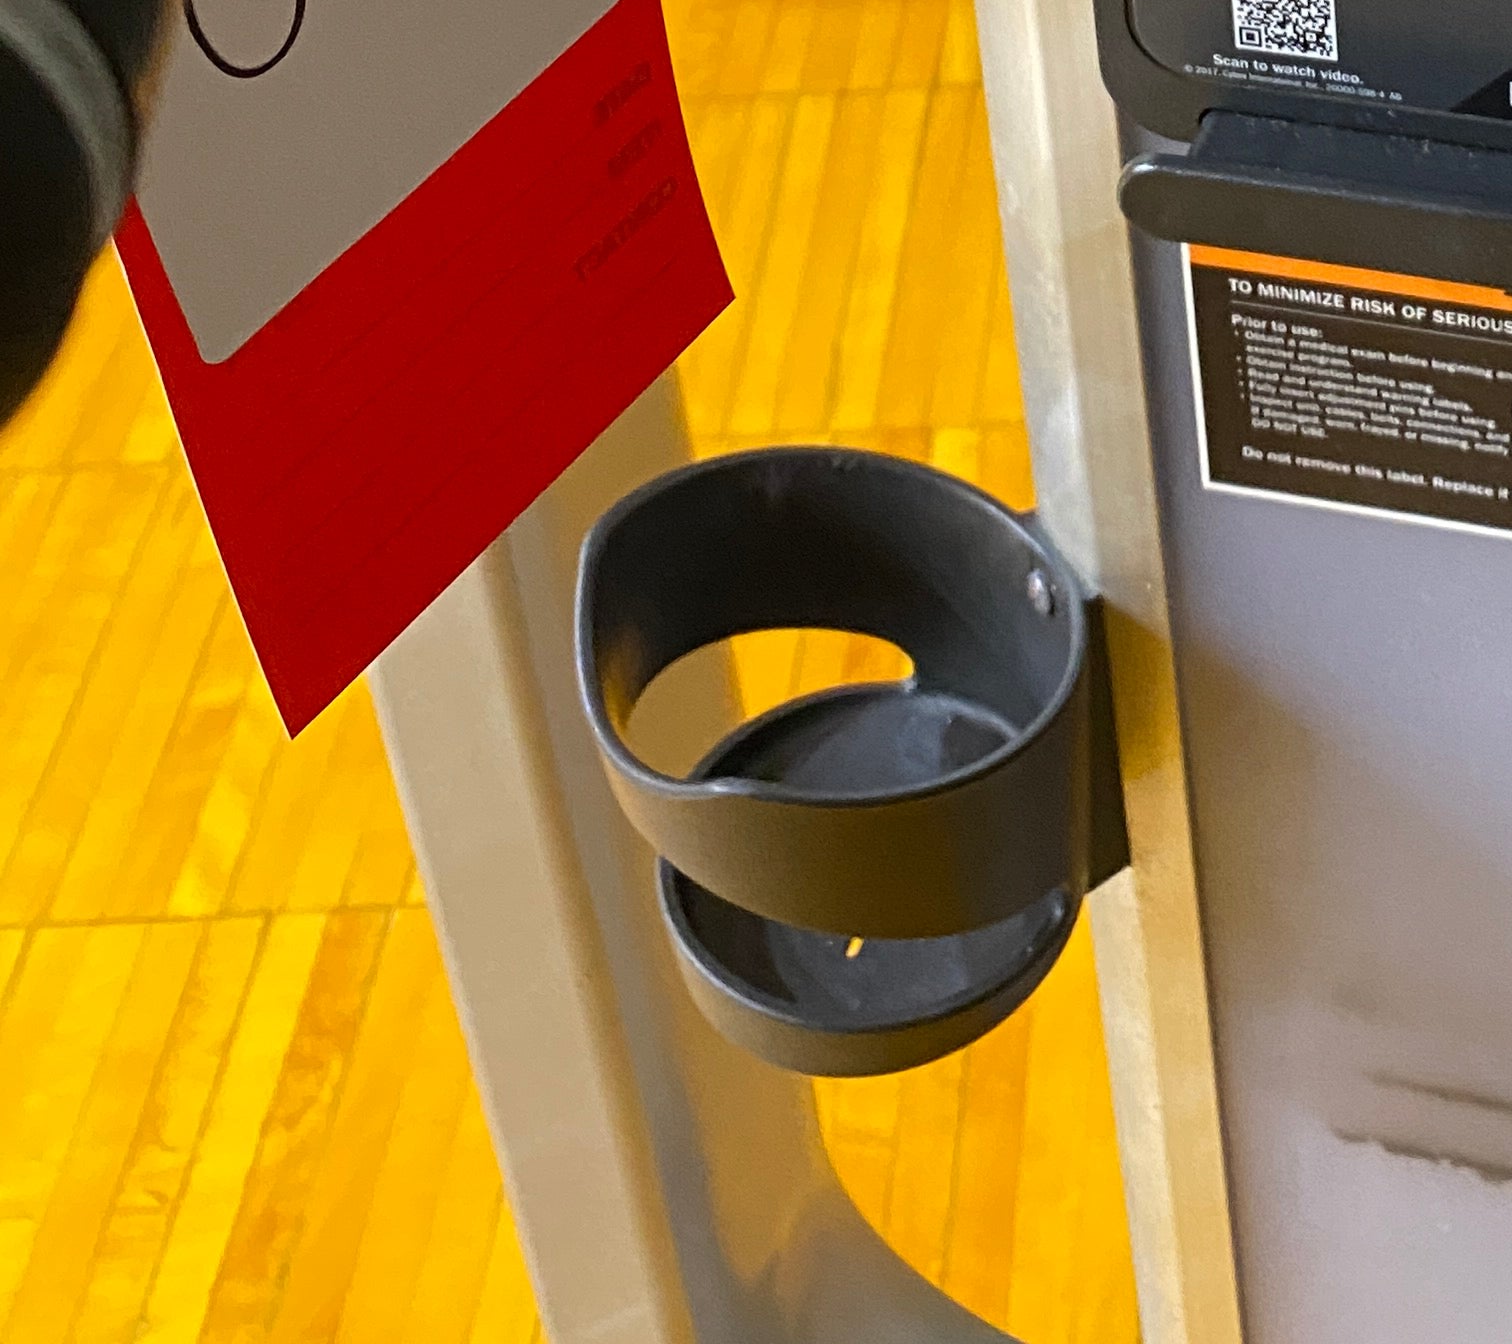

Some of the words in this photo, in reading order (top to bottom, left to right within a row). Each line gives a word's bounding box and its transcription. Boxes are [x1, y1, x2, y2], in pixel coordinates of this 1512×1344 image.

[1212, 53, 1249, 69] Scan
[1252, 59, 1269, 72] to
[1271, 63, 1316, 79] watch
[1319, 69, 1364, 85] video.
[1227, 277, 1253, 295] TO
[1257, 282, 1345, 309] MINIMIZE
[1350, 296, 1396, 317] RISK
[1401, 304, 1427, 321] OF
[1231, 313, 1267, 330] Prior
[1270, 319, 1288, 333] to
[1290, 324, 1323, 338] use:
[1241, 445, 1264, 461] Do
[1266, 451, 1292, 466] not
[1294, 456, 1352, 475] remove
[1354, 464, 1384, 480] this
[1386, 469, 1428, 486] label.
[1431, 476, 1494, 498] Replace
[1497, 487, 1509, 500] if
